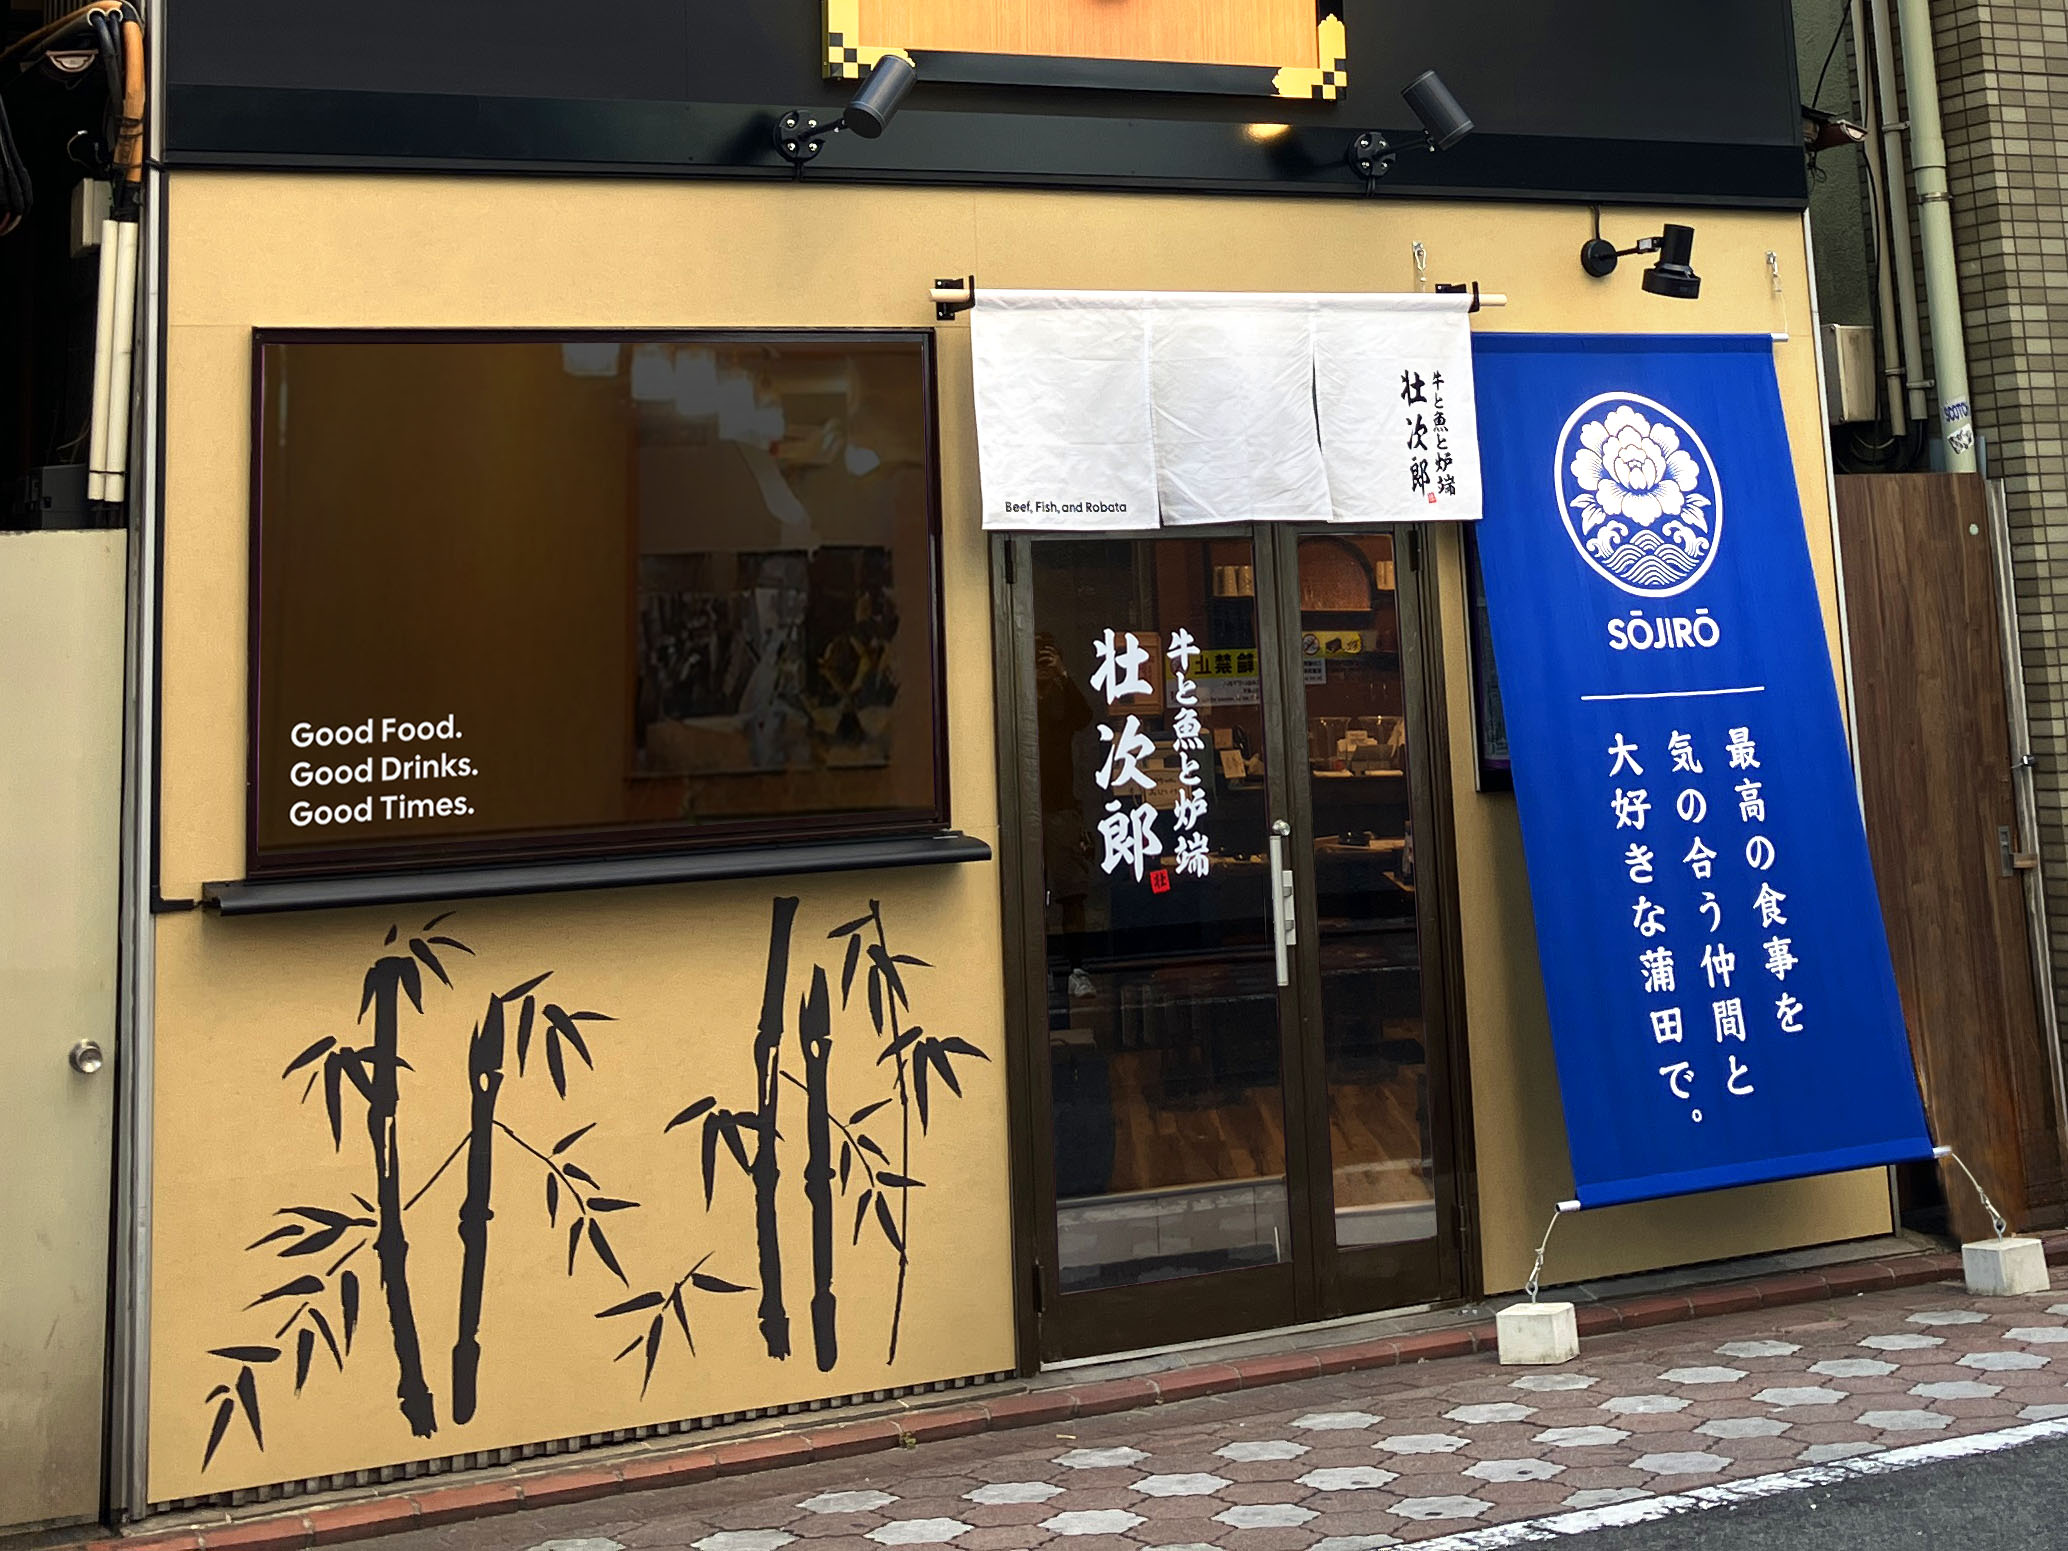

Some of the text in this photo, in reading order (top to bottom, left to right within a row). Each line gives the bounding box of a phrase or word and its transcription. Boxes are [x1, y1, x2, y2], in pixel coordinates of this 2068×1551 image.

[1400, 369, 1431, 497] 壮次郎
[1432, 370, 1456, 496] 牛と魚と炉端
[1005, 501, 1127, 515] Beef, Fish, and Robata
[1607, 606, 1721, 651] SŌJIRŌ
[289, 752, 479, 787] Good Drinks.
[290, 713, 463, 748] Good Food.
[1089, 628, 1163, 883] 壮次郎
[1166, 627, 1211, 879] 牛と魚と炉端
[289, 793, 475, 827] Good Times.
[1607, 731, 1703, 1123] 大好きな蒲田で。
[1667, 729, 1755, 1098] 気の合う仲間と
[1726, 727, 1805, 1034] 最高の食事を
